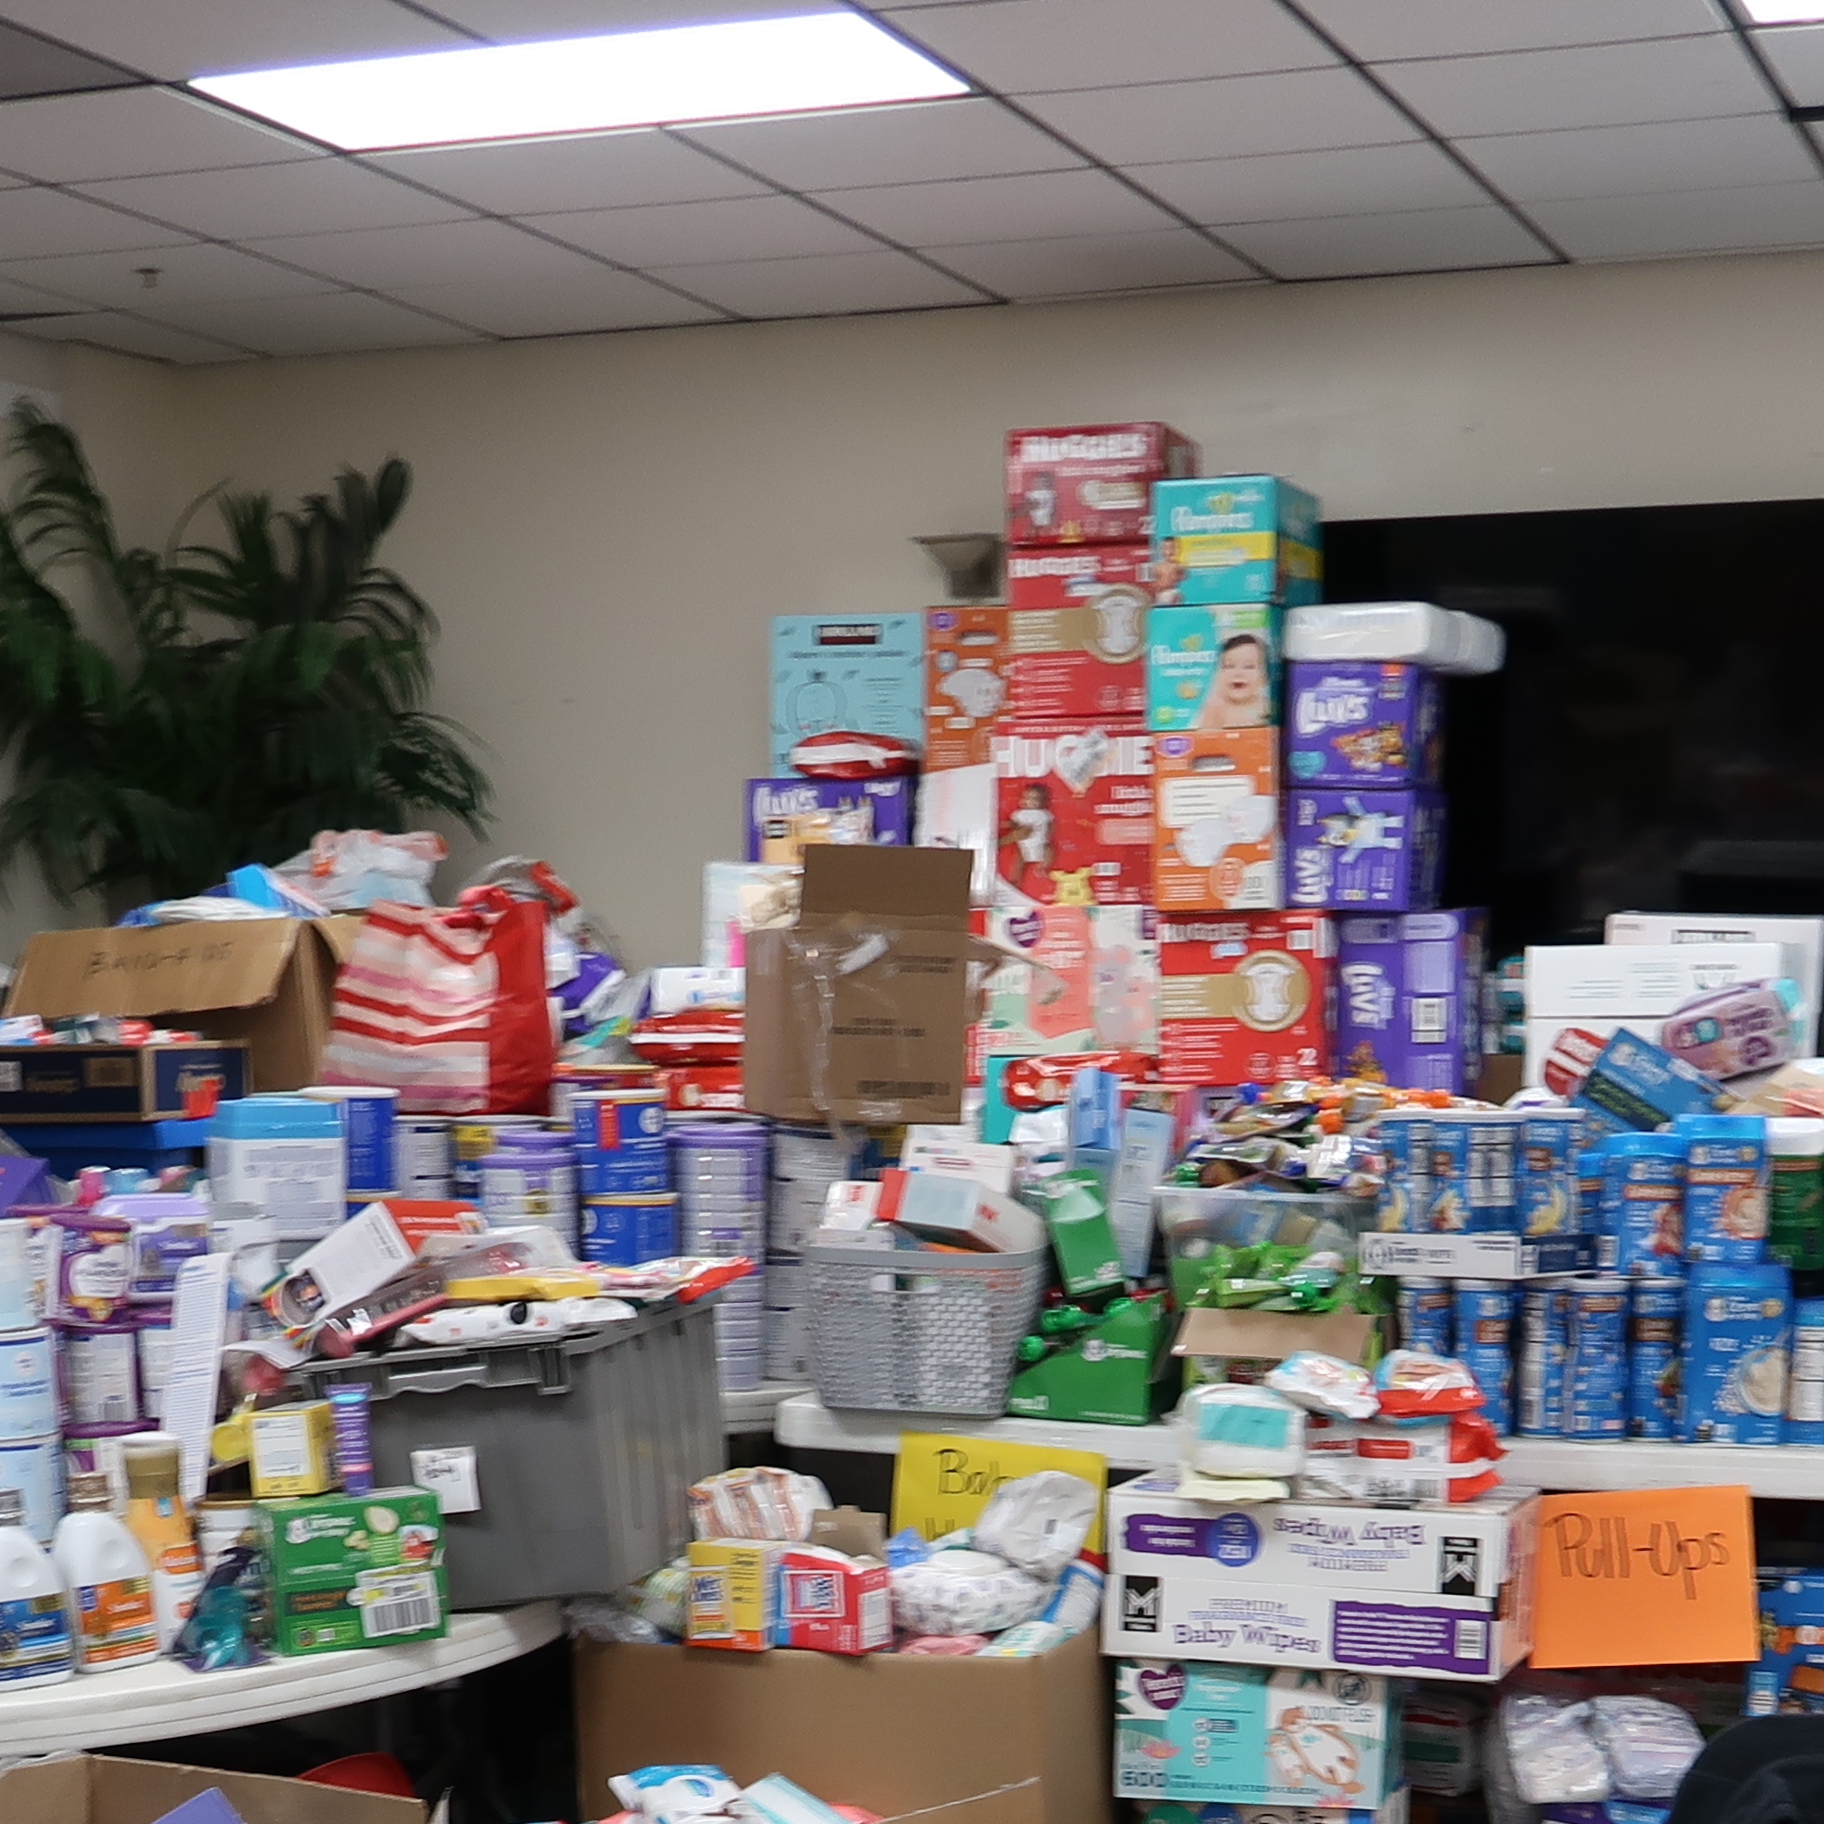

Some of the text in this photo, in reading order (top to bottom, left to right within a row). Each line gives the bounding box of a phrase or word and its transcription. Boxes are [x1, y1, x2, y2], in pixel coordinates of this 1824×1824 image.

[933, 1447, 1012, 1497] Bab
[1543, 1511, 1733, 1600] Pull-Ups
[1172, 1622, 1322, 1653] Baby Wipes
